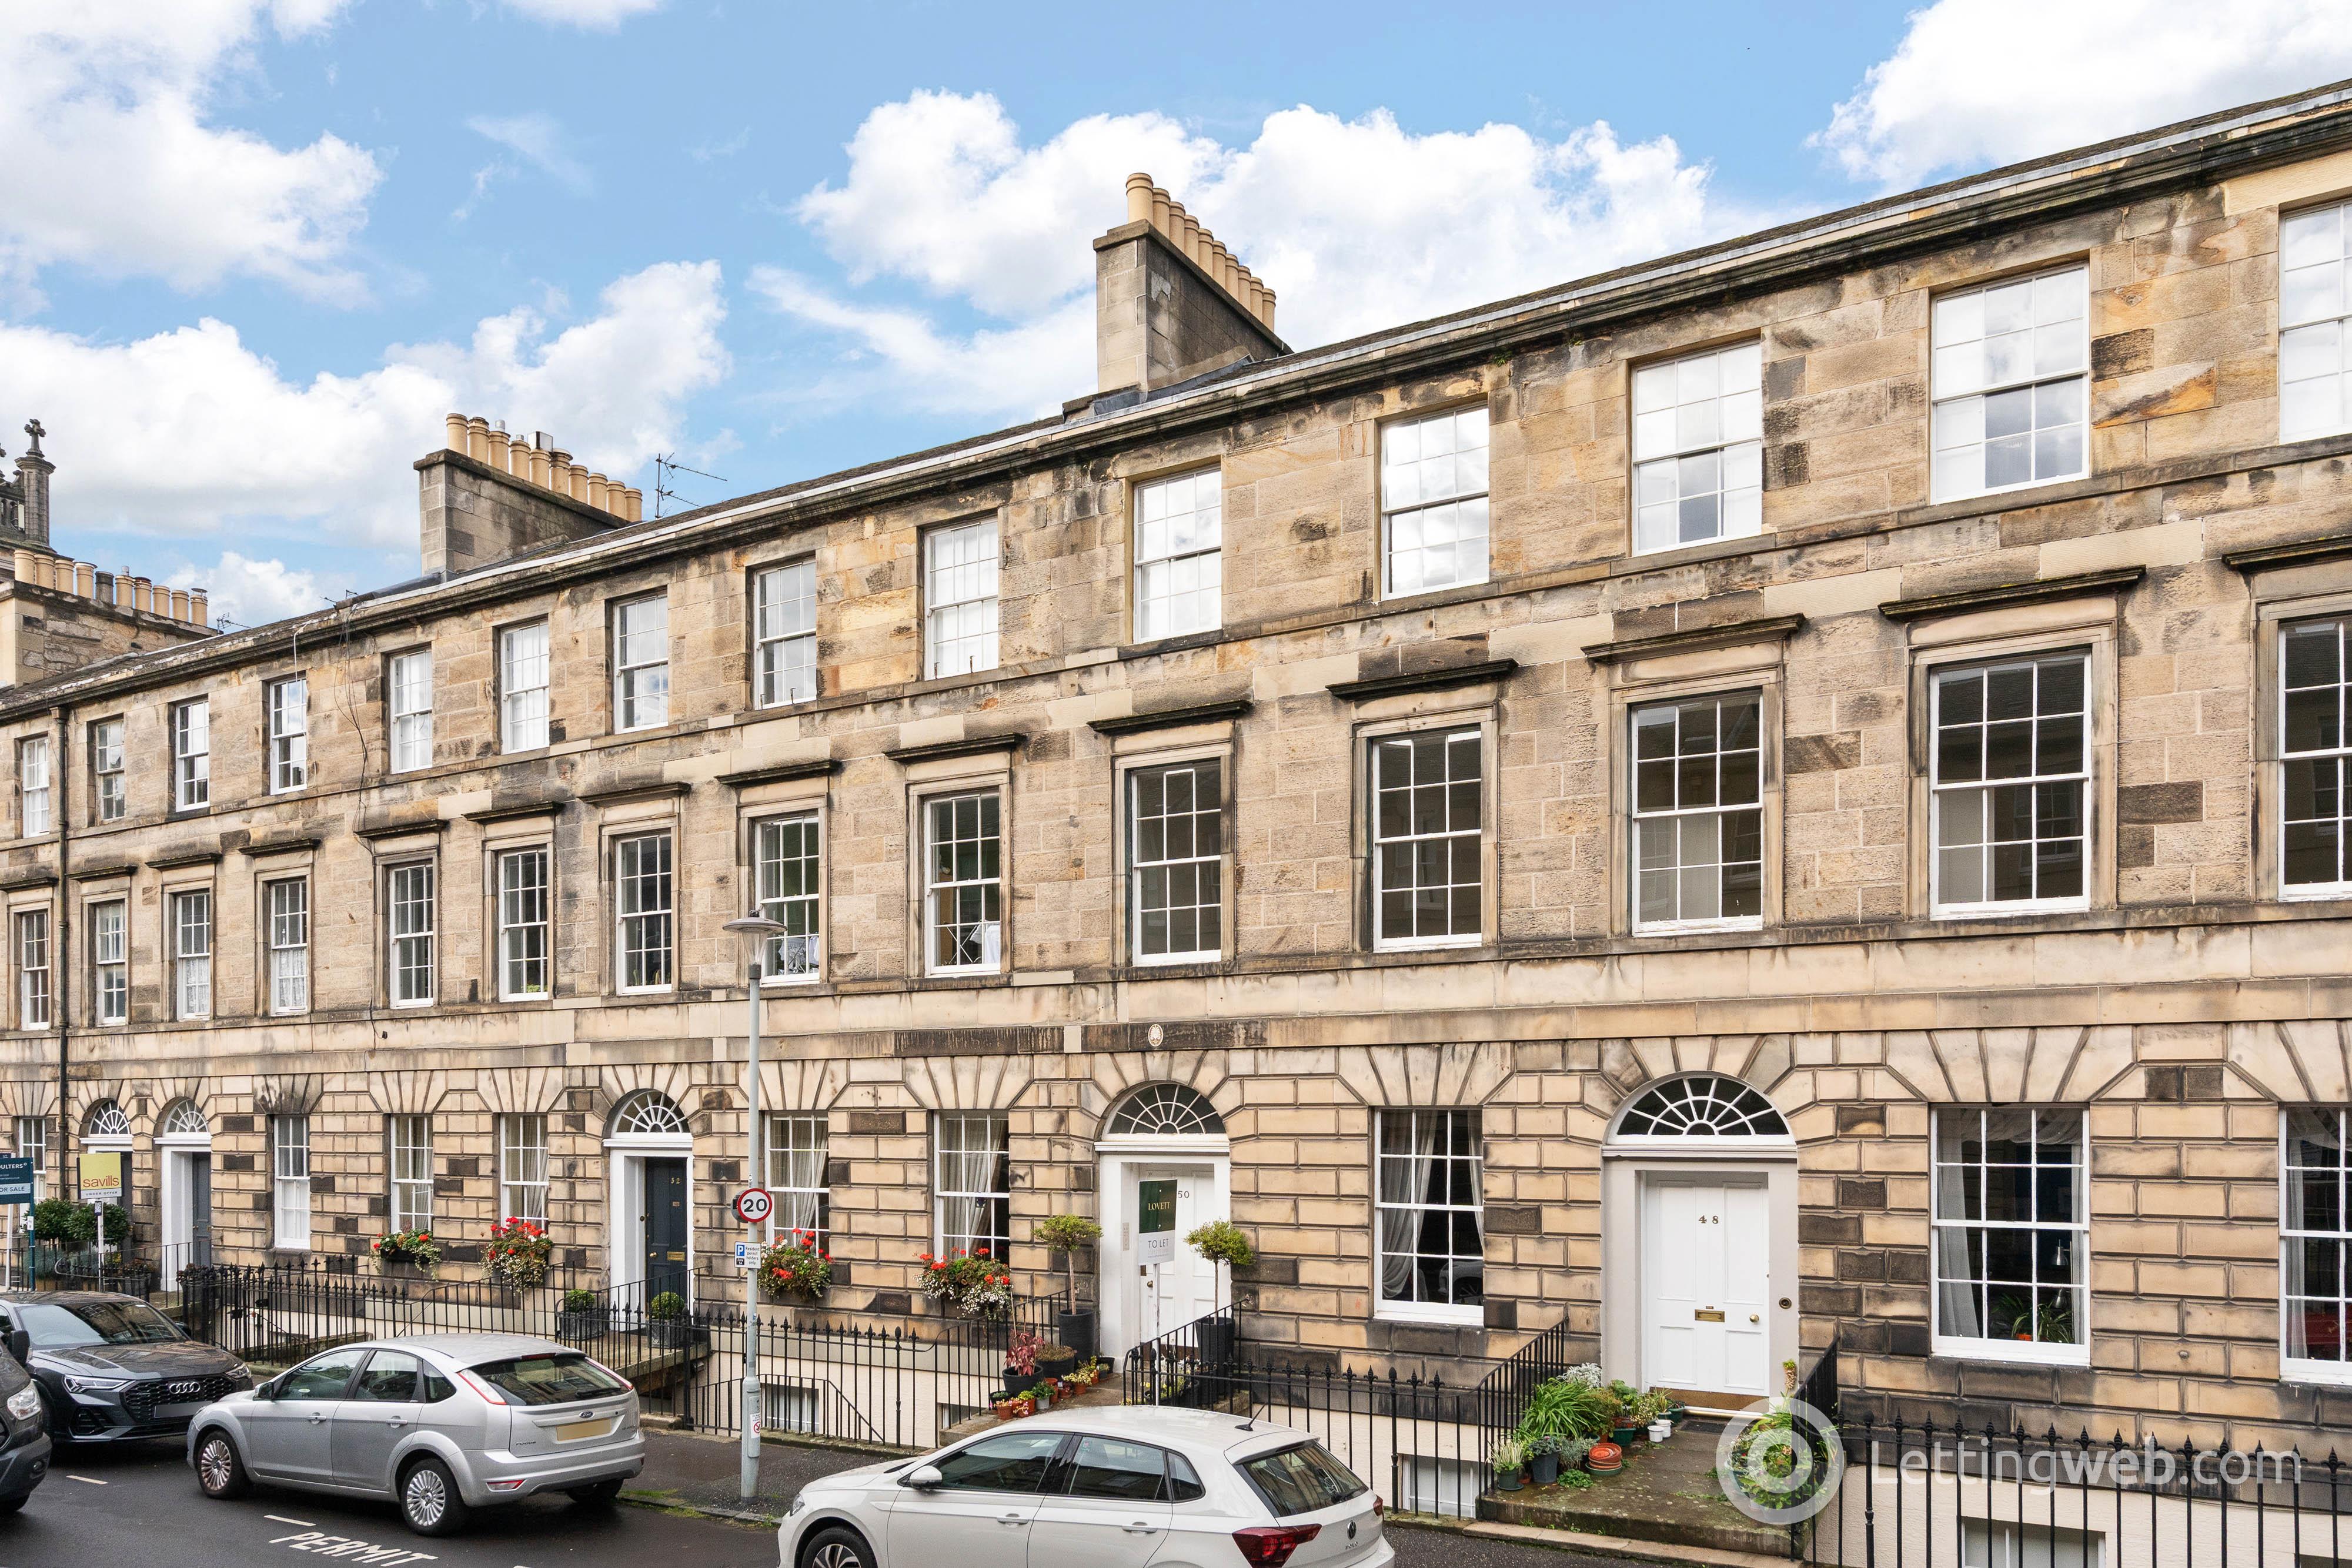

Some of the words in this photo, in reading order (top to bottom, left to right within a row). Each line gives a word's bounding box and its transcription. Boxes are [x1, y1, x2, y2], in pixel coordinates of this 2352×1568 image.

[83, 1175, 119, 1188] savills
[743, 1198, 767, 1212] 20
[1148, 1202, 1170, 1211] LOVETT
[1148, 1240, 1157, 1248] TO
[1160, 1239, 1168, 1247] LET
[737, 1245, 744, 1256] P
[268, 1532, 439, 1567] PERMIT
